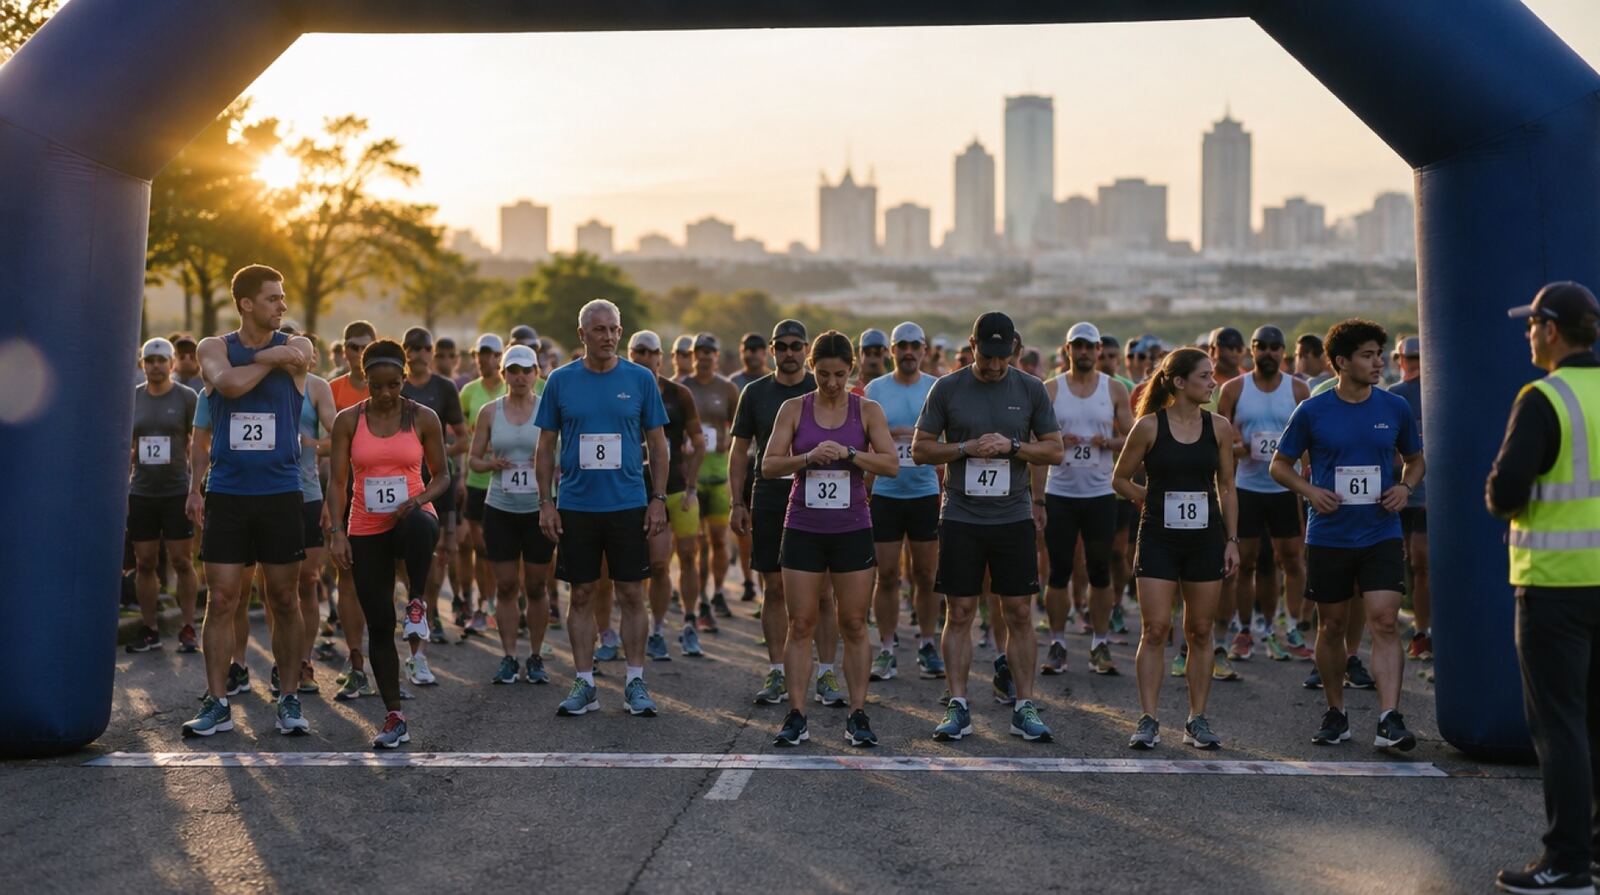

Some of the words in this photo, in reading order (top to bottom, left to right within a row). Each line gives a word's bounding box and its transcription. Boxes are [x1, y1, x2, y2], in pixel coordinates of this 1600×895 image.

[242, 424, 263, 441] 23
[146, 444, 161, 459] 12
[595, 444, 606, 461] 8
[510, 470, 528, 487] 41
[977, 469, 998, 487] 47
[1350, 477, 1369, 495] 61
[376, 487, 396, 504] 15
[817, 481, 838, 500] 32
[1177, 502, 1197, 520] 18
